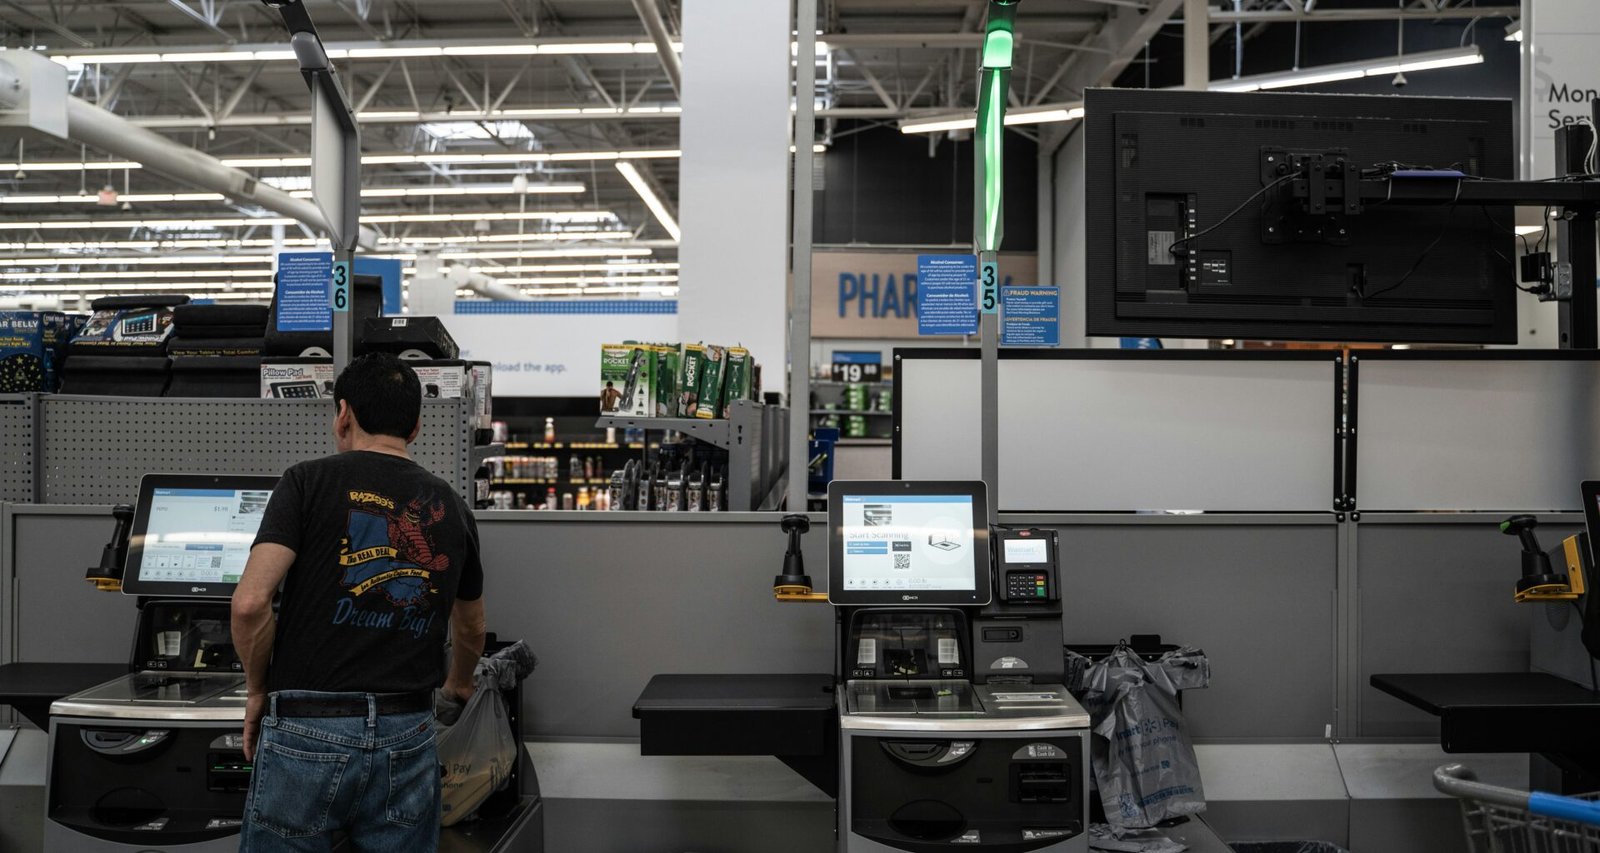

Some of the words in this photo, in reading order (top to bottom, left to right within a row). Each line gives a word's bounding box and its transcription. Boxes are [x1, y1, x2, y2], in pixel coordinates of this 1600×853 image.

[1549, 83, 1600, 104] Mon
[263, 368, 286, 377] Pillow
[287, 367, 303, 376] Pad
[524, 362, 542, 372] the
[686, 355, 697, 387] ROCKET
[358, 551, 374, 561] REAL
[375, 548, 390, 557] DEAL
[332, 597, 395, 628] Dream
[399, 605, 436, 640] Big!
[453, 764, 471, 775] Pay
